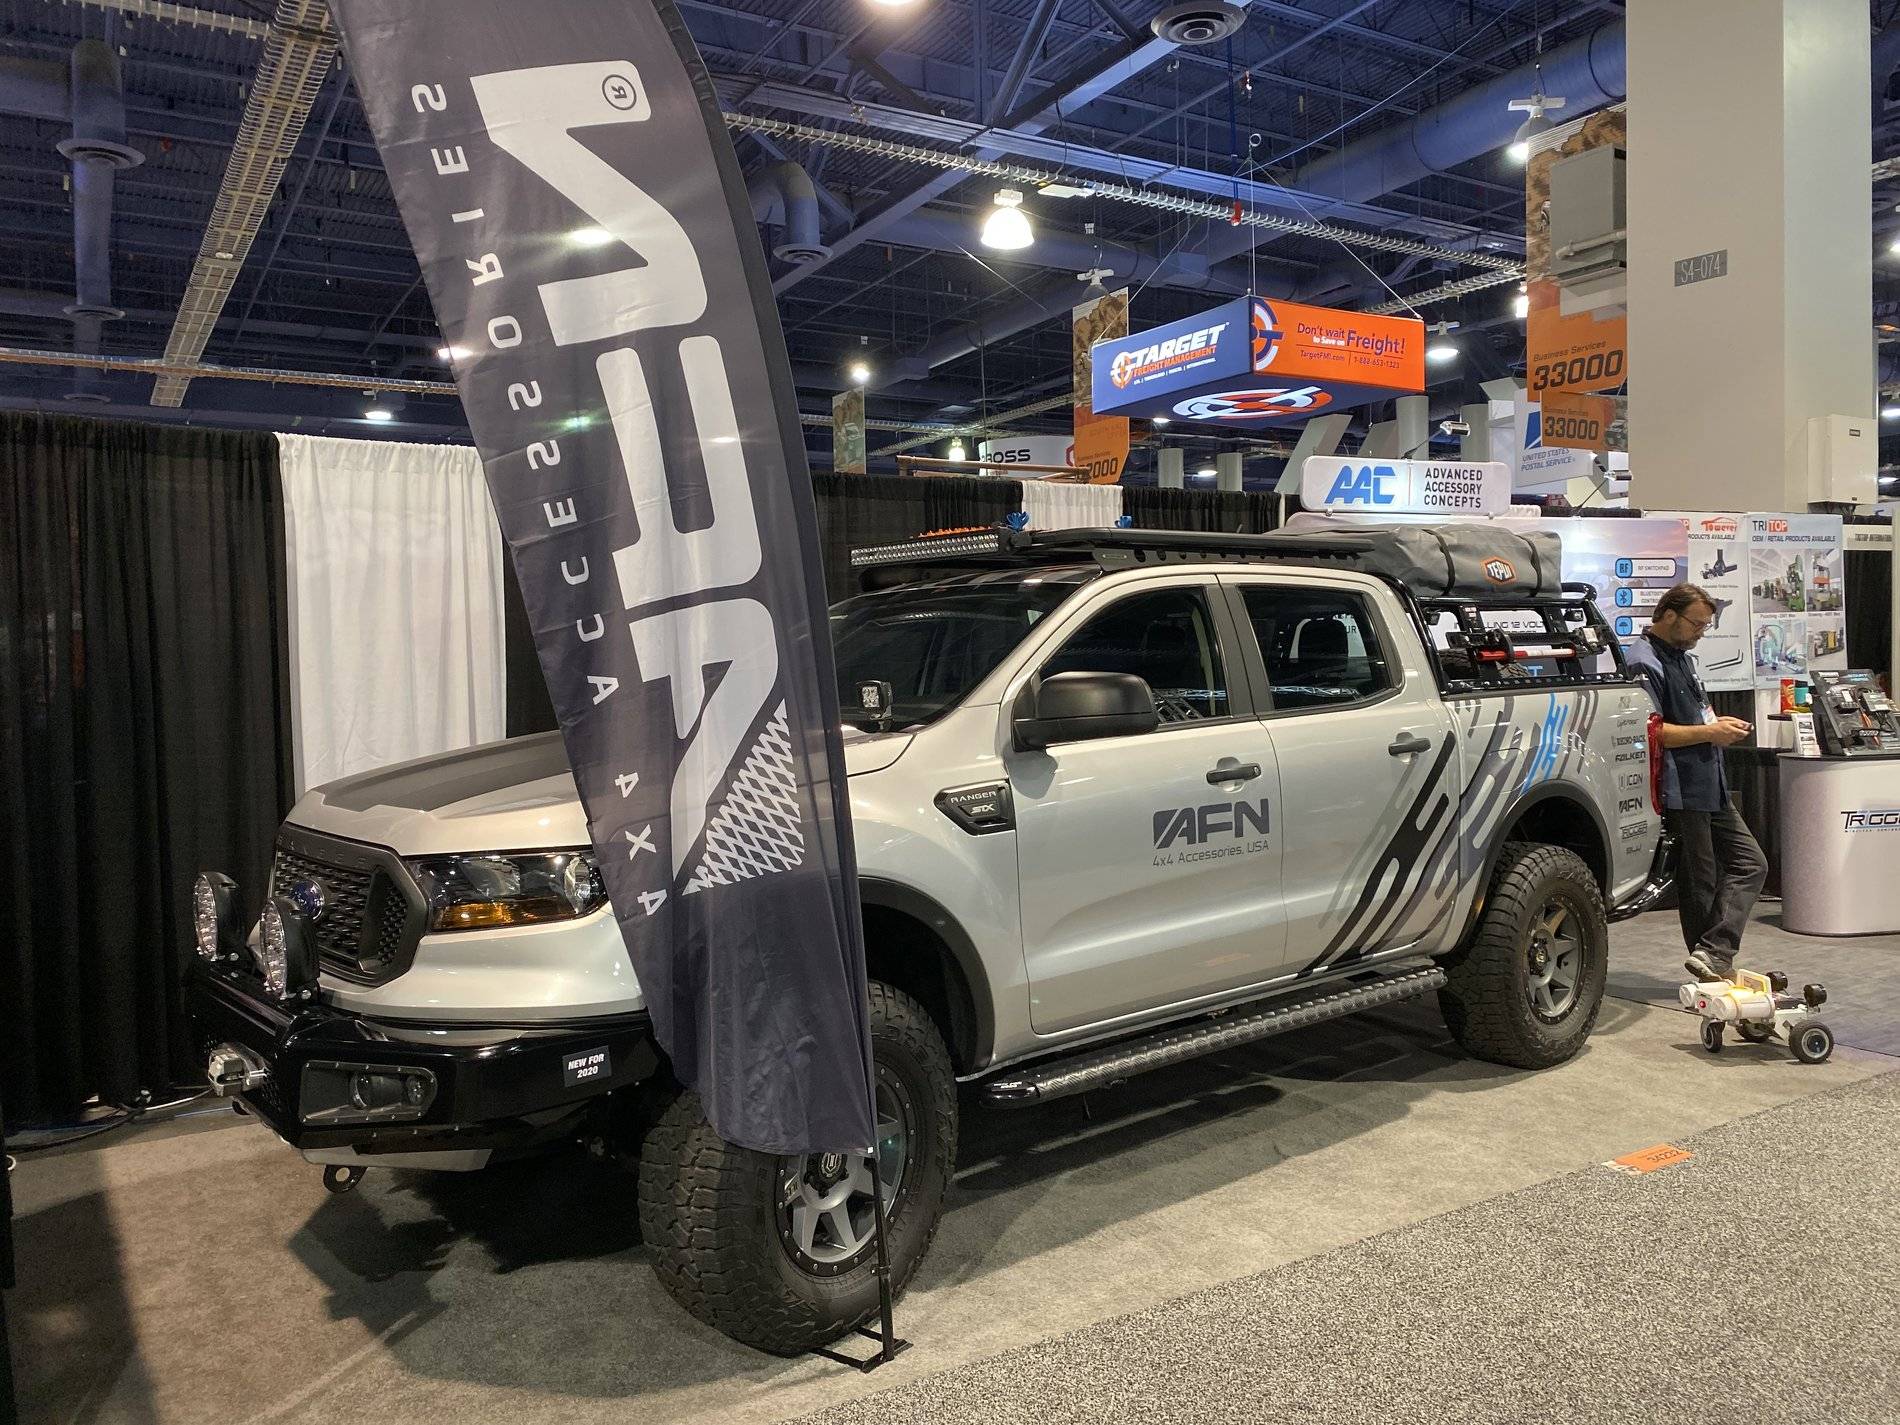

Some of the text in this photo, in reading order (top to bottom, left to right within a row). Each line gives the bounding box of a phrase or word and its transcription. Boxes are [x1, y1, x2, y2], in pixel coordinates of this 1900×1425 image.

[1681, 253, 1720, 283] S4-074
[1297, 322, 1345, 339] Don't wait
[1129, 323, 1226, 368] TARGET
[1312, 335, 1321, 344] to
[1346, 329, 1406, 356] Freight!
[1533, 340, 1607, 362] Business Services
[1133, 357, 1165, 378] FREIGHT
[1164, 344, 1217, 368] MANAGEMENT
[1532, 349, 1624, 391] 33000
[1544, 416, 1600, 441] 33000
[1522, 447, 1570, 462] UNITED STATES
[1520, 457, 1572, 472] POSTAL SERVICE
[1425, 467, 1483, 481] ADVANCED
[1424, 481, 1482, 495] ACCESSORY
[1423, 494, 1482, 508] CONCEPTS
[1511, 621, 1521, 629] 12
[1615, 751, 1646, 763] FALKEN
[950, 791, 997, 804] RANGER
[1153, 798, 1270, 850] AFN
[1840, 810, 1900, 830] TRIGG
[1152, 854, 1175, 867] 4x4
[1247, 839, 1270, 853] USA
[567, 1053, 605, 1071] NEW FOR
[576, 1065, 599, 1079] 2020
